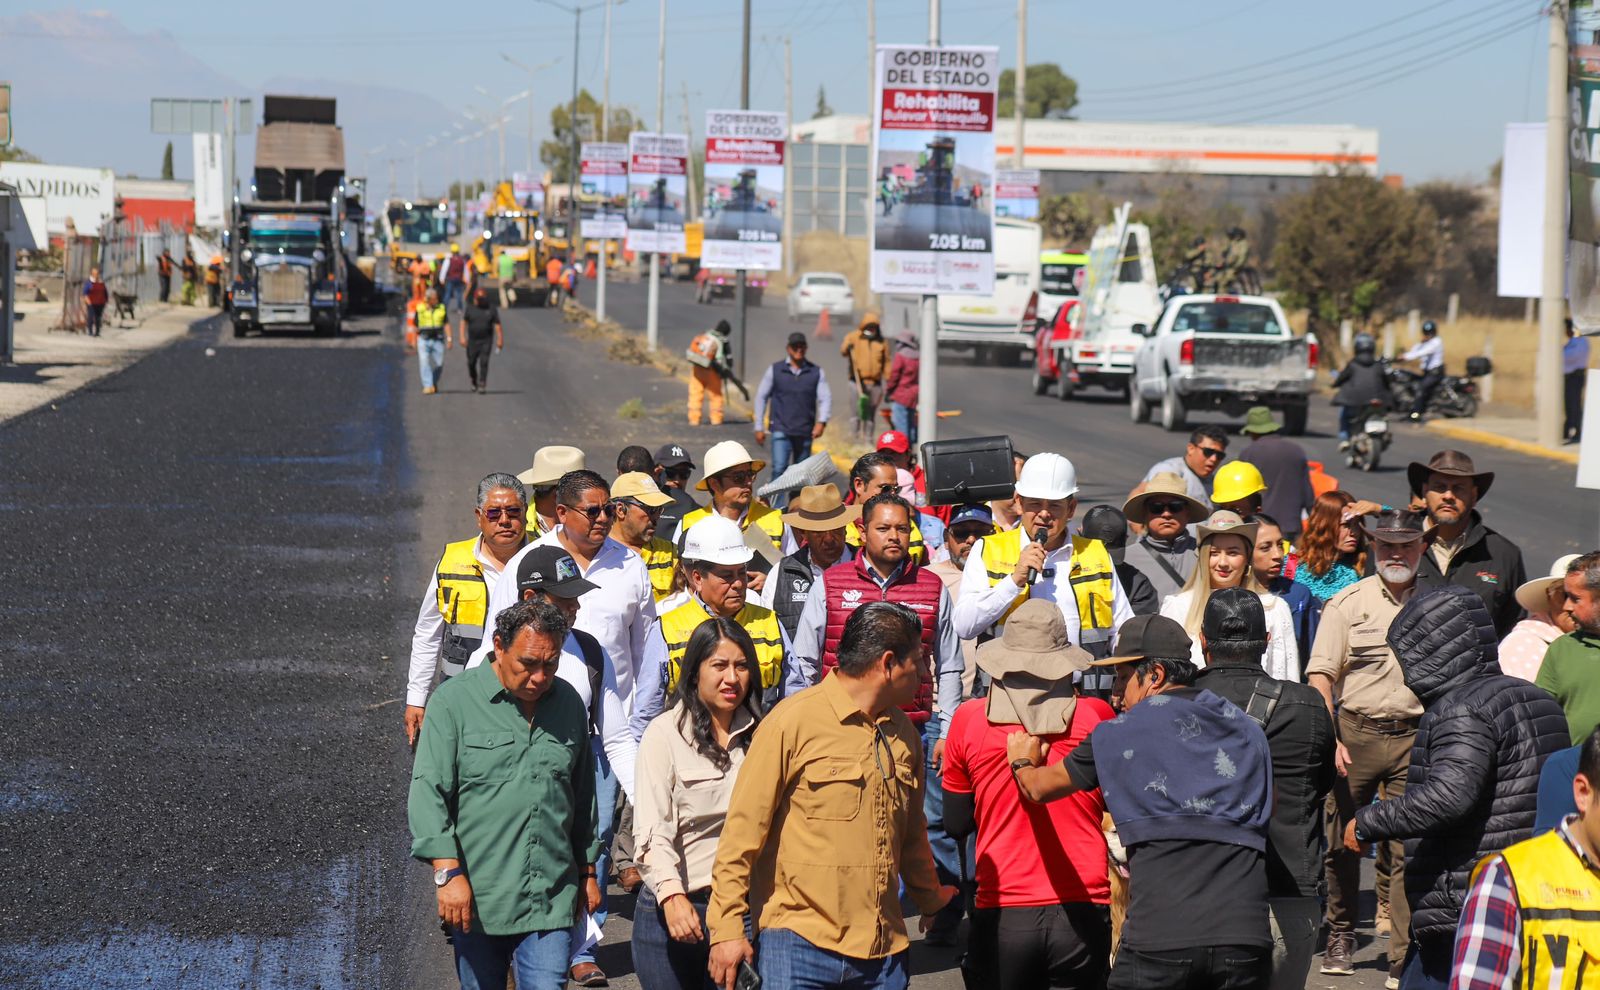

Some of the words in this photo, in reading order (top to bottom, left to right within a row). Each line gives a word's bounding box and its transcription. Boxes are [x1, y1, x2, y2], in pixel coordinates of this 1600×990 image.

[894, 51, 985, 68] GOBIERNO
[887, 69, 917, 83] DEL
[923, 70, 990, 87] ESTADO
[894, 91, 981, 111] Rehabilita
[714, 113, 778, 125] GOBIERNO
[709, 125, 731, 135] DEL
[735, 126, 782, 137] ESTADO
[0, 176, 100, 198] ANDIDOS
[760, 230, 778, 241] km
[928, 233, 960, 250] 7.05
[961, 235, 986, 250] km
